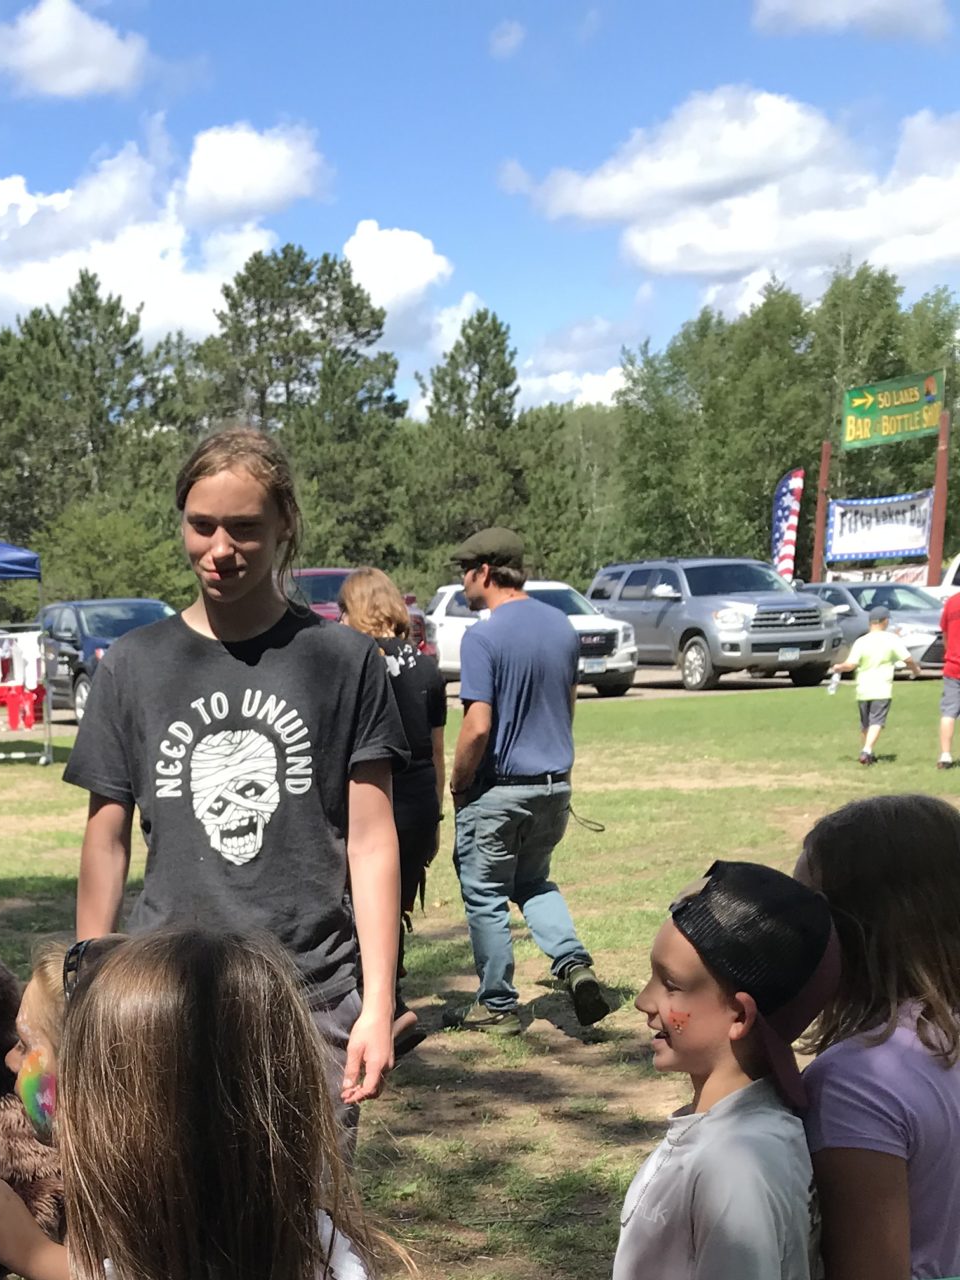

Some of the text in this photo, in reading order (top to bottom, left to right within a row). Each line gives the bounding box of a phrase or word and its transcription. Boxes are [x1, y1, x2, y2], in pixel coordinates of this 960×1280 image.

[878, 386, 920, 409] 50 LAKES
[845, 415, 871, 441] BAR
[881, 411, 921, 436] BOTTLE
[839, 509, 872, 538] Fifty
[874, 506, 907, 526] Lakes
[155, 688, 313, 798] NEED TO UNWIND
